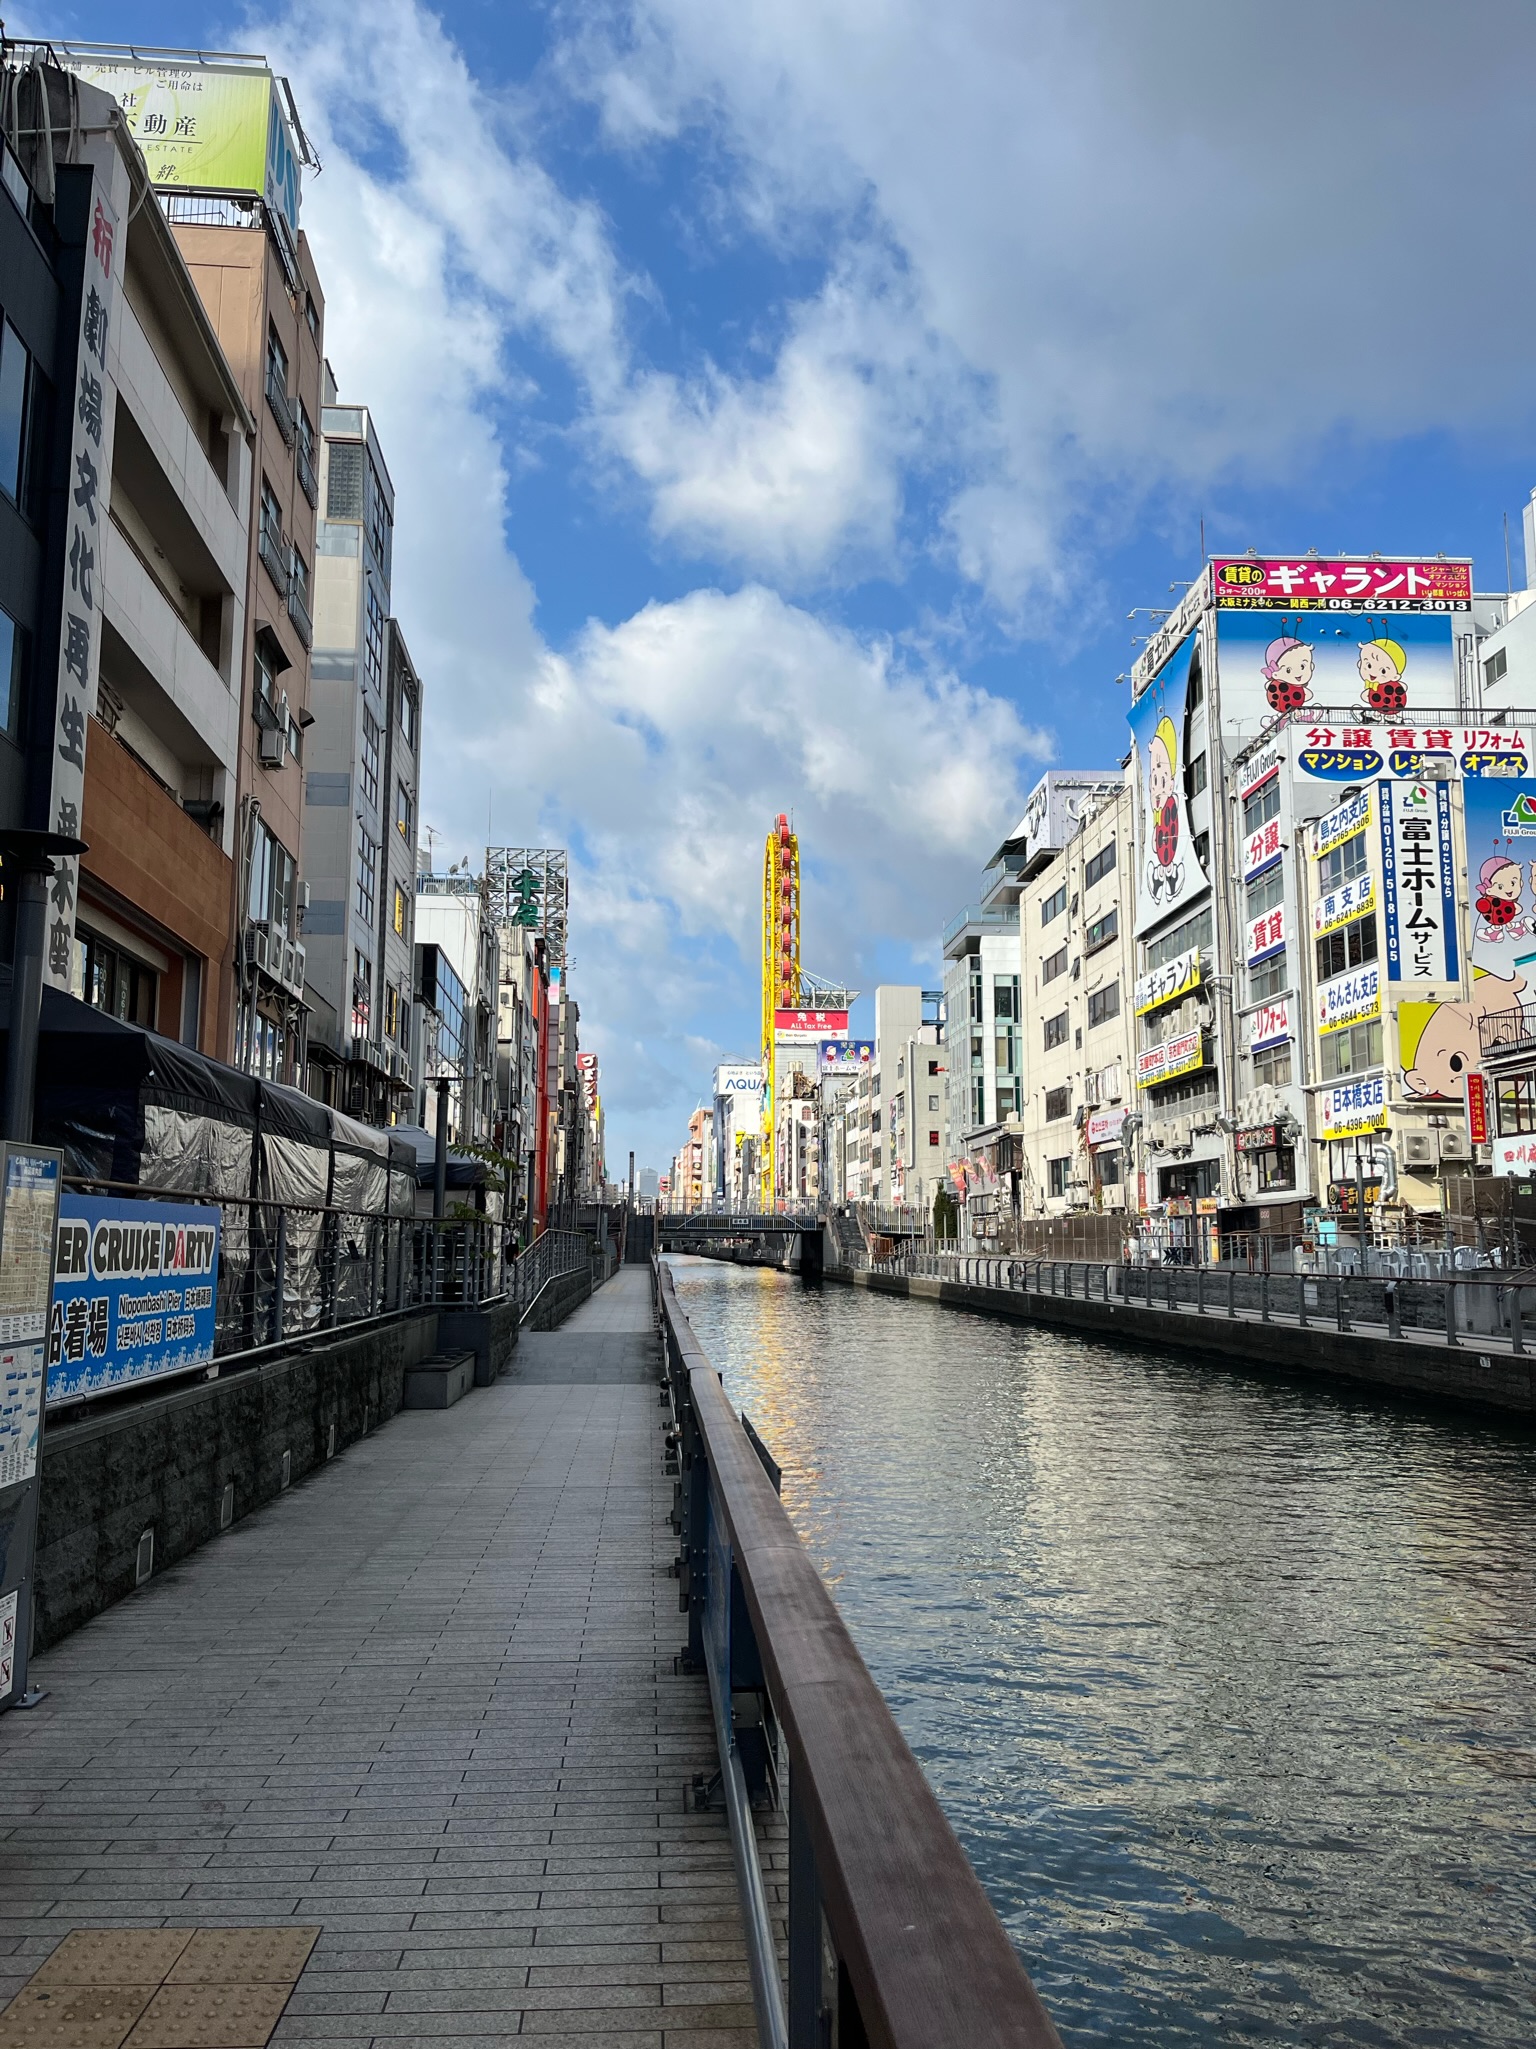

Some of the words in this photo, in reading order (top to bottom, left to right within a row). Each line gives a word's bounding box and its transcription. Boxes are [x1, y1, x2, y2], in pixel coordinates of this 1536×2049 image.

[120, 93, 137, 108] 社
[156, 80, 203, 92] ご用命は
[1224, 566, 1262, 584] 賃貸の
[1267, 564, 1432, 595] ギャラント
[1328, 599, 1468, 611] 06-6212-3013
[1306, 728, 1373, 747] 分譲
[1386, 729, 1454, 749] 賃貸
[1464, 730, 1526, 751] リフォーム
[1246, 758, 1259, 786] FUJI
[1260, 749, 1277, 774] Group
[1304, 753, 1379, 771] マンション
[1465, 755, 1526, 771] オフィス
[1320, 793, 1369, 840] 島之内支店
[1321, 814, 1370, 851] 06-6765-1306
[1250, 821, 1279, 865] 分譲
[1324, 876, 1371, 918] 南支店
[1325, 898, 1374, 929] 06-6241-8839
[1399, 817, 1438, 977] 富士ホームサービス
[1253, 910, 1283, 952] 賃貸
[1147, 954, 1198, 1006] ギャラント
[1328, 971, 1378, 1010] なんさん支店
[1256, 999, 1288, 1040] リフォーム
[1328, 1001, 1379, 1028] 06-6644-5573
[1333, 1079, 1383, 1112] 日本橋支店
[1334, 1113, 1384, 1133] 06-4396-7000
[93, 1226, 161, 1273] CRUISE
[164, 1230, 214, 1270] PARTY
[119, 1292, 166, 1317] Nippombashi
[168, 1290, 181, 1309] Pier
